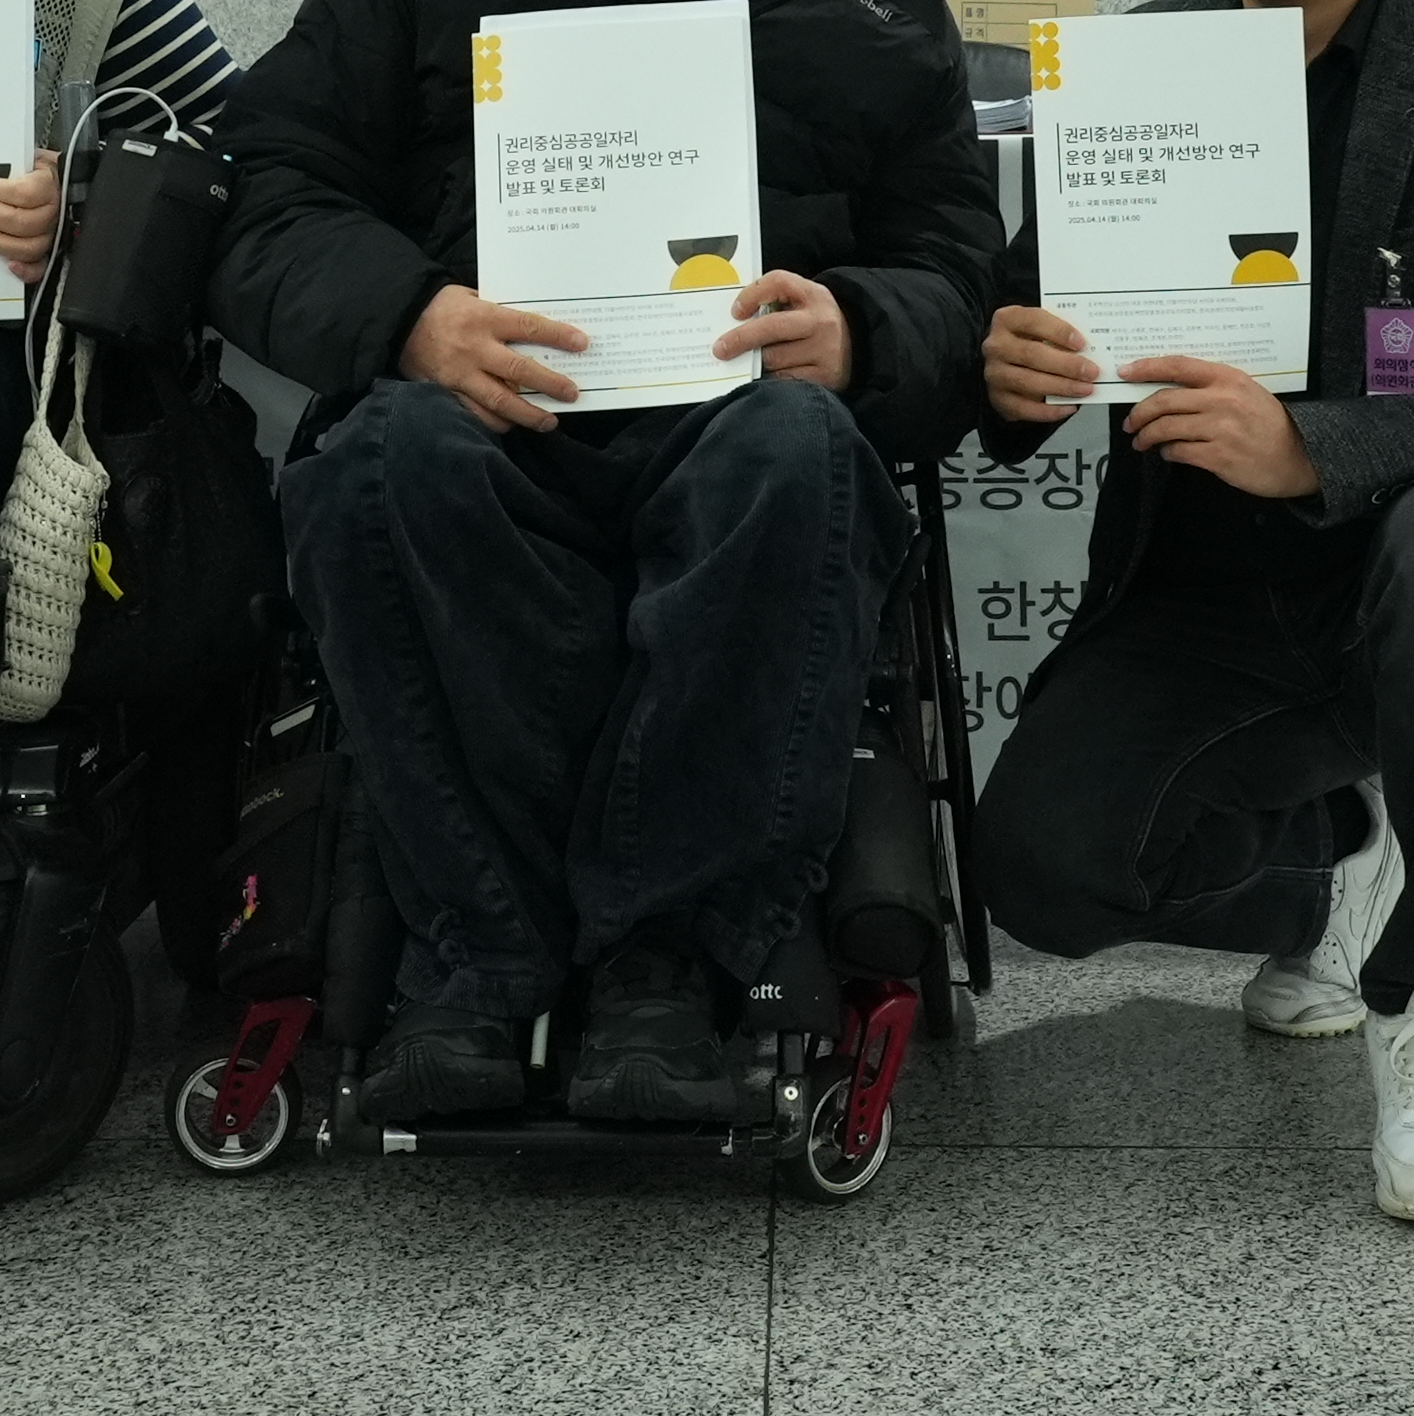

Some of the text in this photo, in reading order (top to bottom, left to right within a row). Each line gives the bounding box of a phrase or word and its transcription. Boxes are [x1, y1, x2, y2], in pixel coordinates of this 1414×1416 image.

[505, 130, 638, 154] 권리중심공공일자리
[1063, 122, 1199, 144] 권리중심공공일자리
[506, 149, 700, 176] 운영 실태 및 개선방안 연구
[1066, 142, 1261, 166] 운영 실태 및 개선방안 연구
[506, 176, 606, 197] 발표 및 토론회
[1066, 167, 1166, 188] 발표 및 토론회
